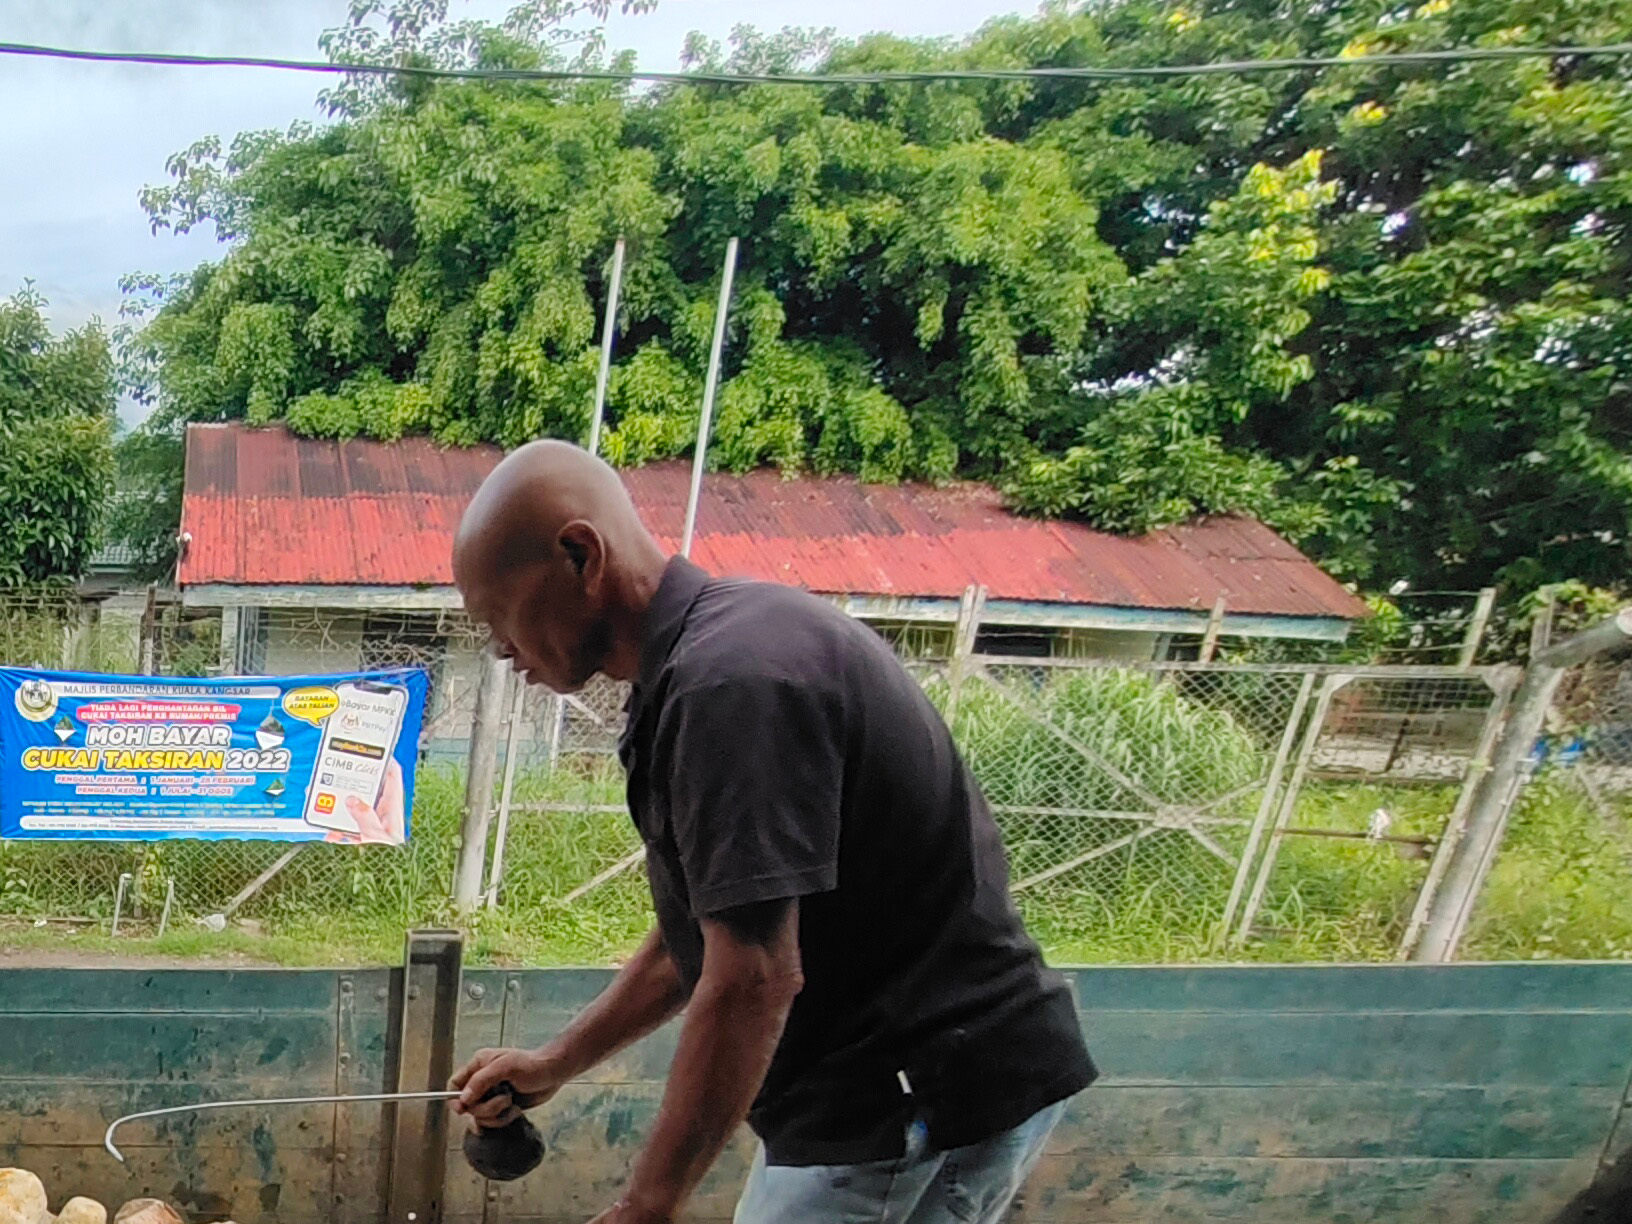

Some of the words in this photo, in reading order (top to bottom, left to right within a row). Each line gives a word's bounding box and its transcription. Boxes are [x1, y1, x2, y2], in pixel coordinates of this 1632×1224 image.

[64, 686, 96, 694] MAJLIS
[100, 686, 169, 695] PERBANDARAN
[173, 687, 202, 695] KUALA
[205, 687, 251, 695] KANGSAR
[81, 712, 108, 720] CUKAI
[111, 712, 153, 720] TAKSIRAN
[88, 726, 144, 746] MOH
[148, 726, 229, 746] BAYAR
[23, 750, 99, 769] CUKAI
[104, 750, 225, 770] TAKSIRAN
[227, 749, 289, 770] 2022
[324, 757, 354, 771] CIMB
